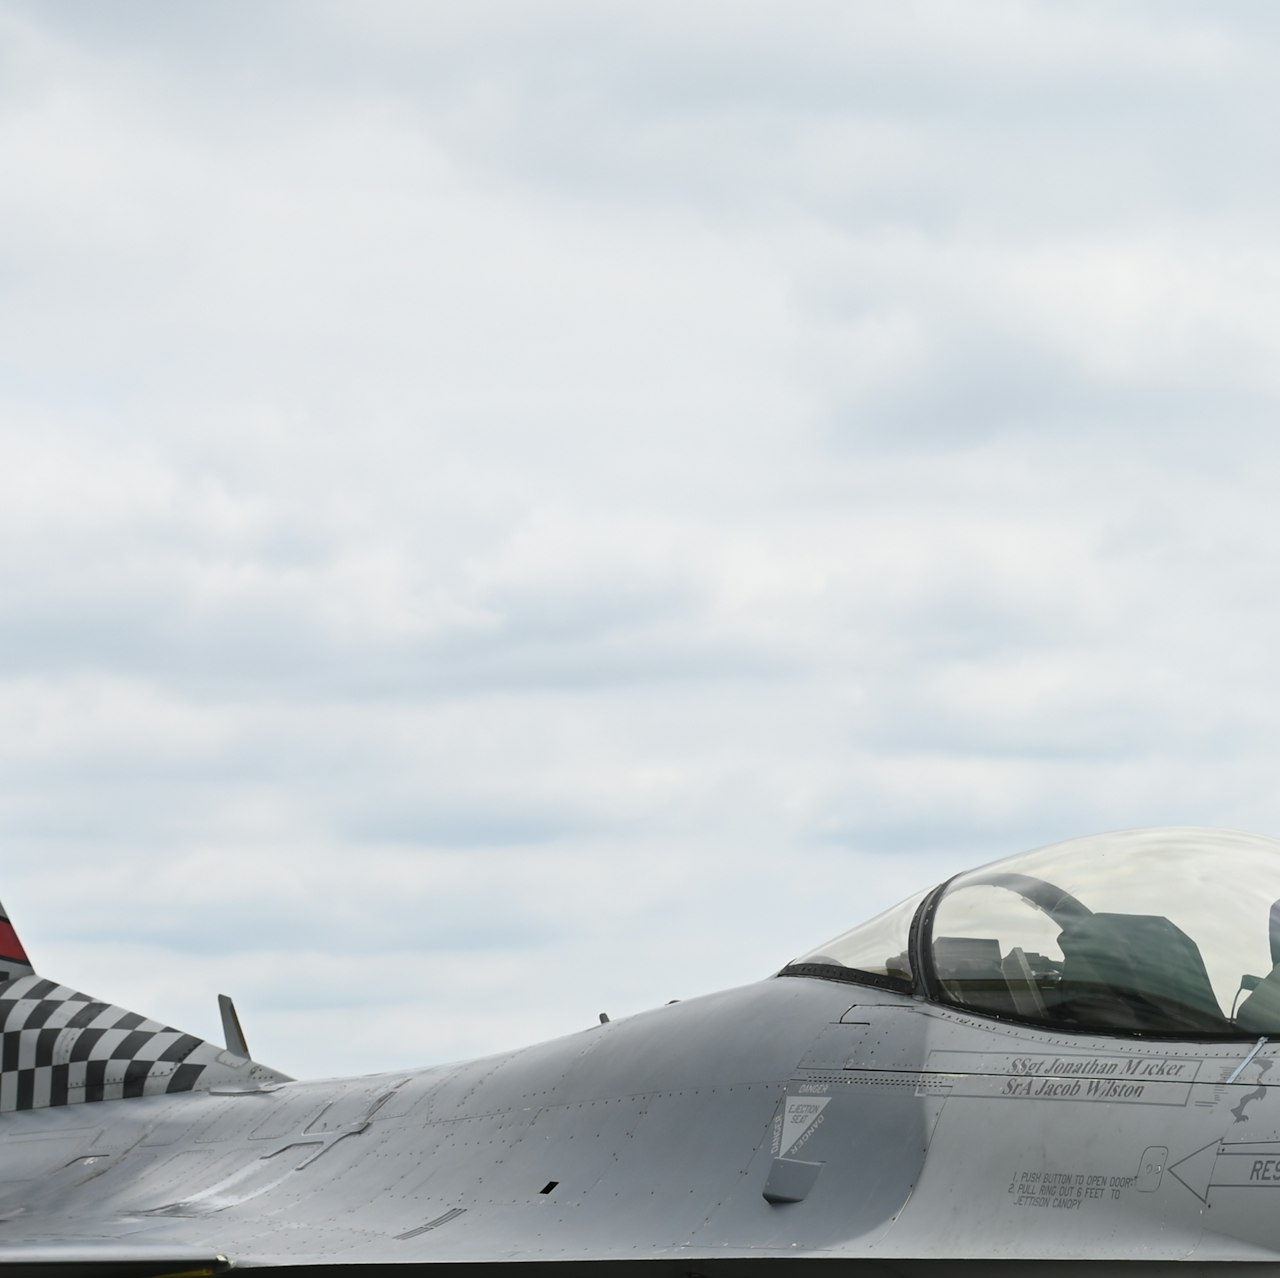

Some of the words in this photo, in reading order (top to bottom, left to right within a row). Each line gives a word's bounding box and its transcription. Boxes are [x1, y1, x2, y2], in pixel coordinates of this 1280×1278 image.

[1007, 1057, 1045, 1076] SSgt
[1044, 1058, 1118, 1075] Jonathan
[1002, 1078, 1034, 1096] SrA
[1035, 1079, 1081, 1097] Jacob
[790, 1114, 825, 1155] DANGER
[1021, 1172, 1041, 1183] PUSH
[1042, 1173, 1072, 1185] BUTTON
[1075, 1175, 1084, 1186] TO
[1086, 1175, 1107, 1187] OPEN
[1017, 1184, 1036, 1195] PULL
[1039, 1185, 1057, 1196] RING
[1058, 1186, 1075, 1197] OUT
[1076, 1187, 1082, 1198] 6
[1084, 1187, 1105, 1199] FEET
[1111, 1188, 1121, 1200] TO
[1013, 1195, 1051, 1208] JETTISON
[1052, 1197, 1082, 1209] CANOPY
